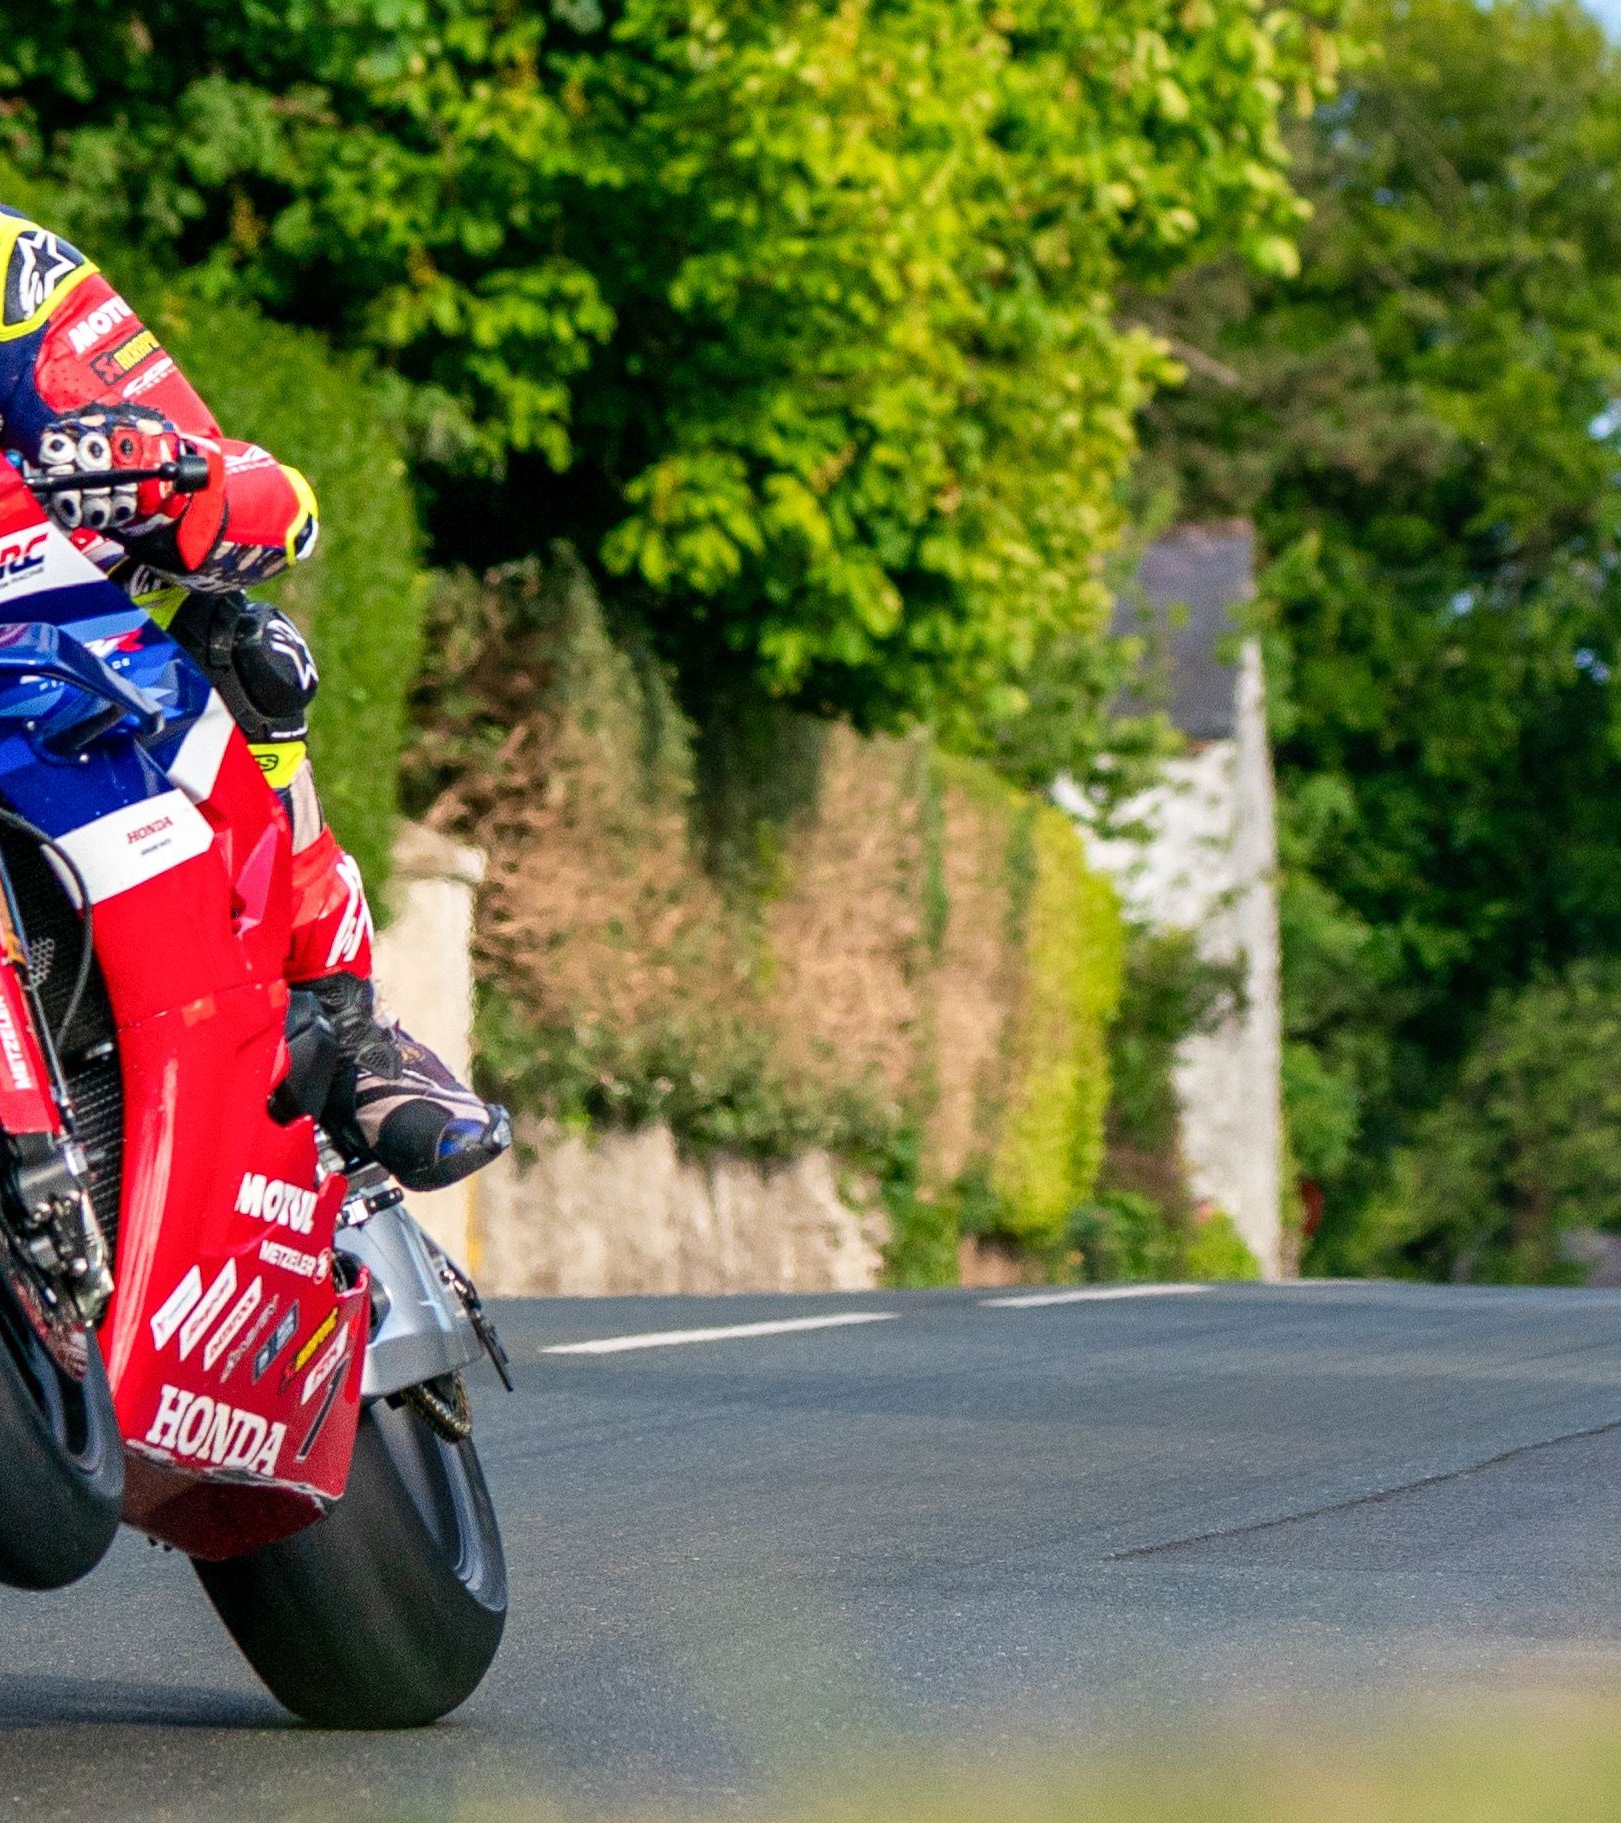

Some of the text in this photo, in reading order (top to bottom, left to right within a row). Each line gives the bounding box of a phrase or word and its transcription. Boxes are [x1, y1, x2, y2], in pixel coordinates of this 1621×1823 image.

[68, 296, 134, 354] MOTU
[126, 816, 173, 844] HONDA
[234, 1171, 319, 1235] MOTUL
[259, 1239, 317, 1278] METZELER
[145, 1383, 287, 1476] HONDA
